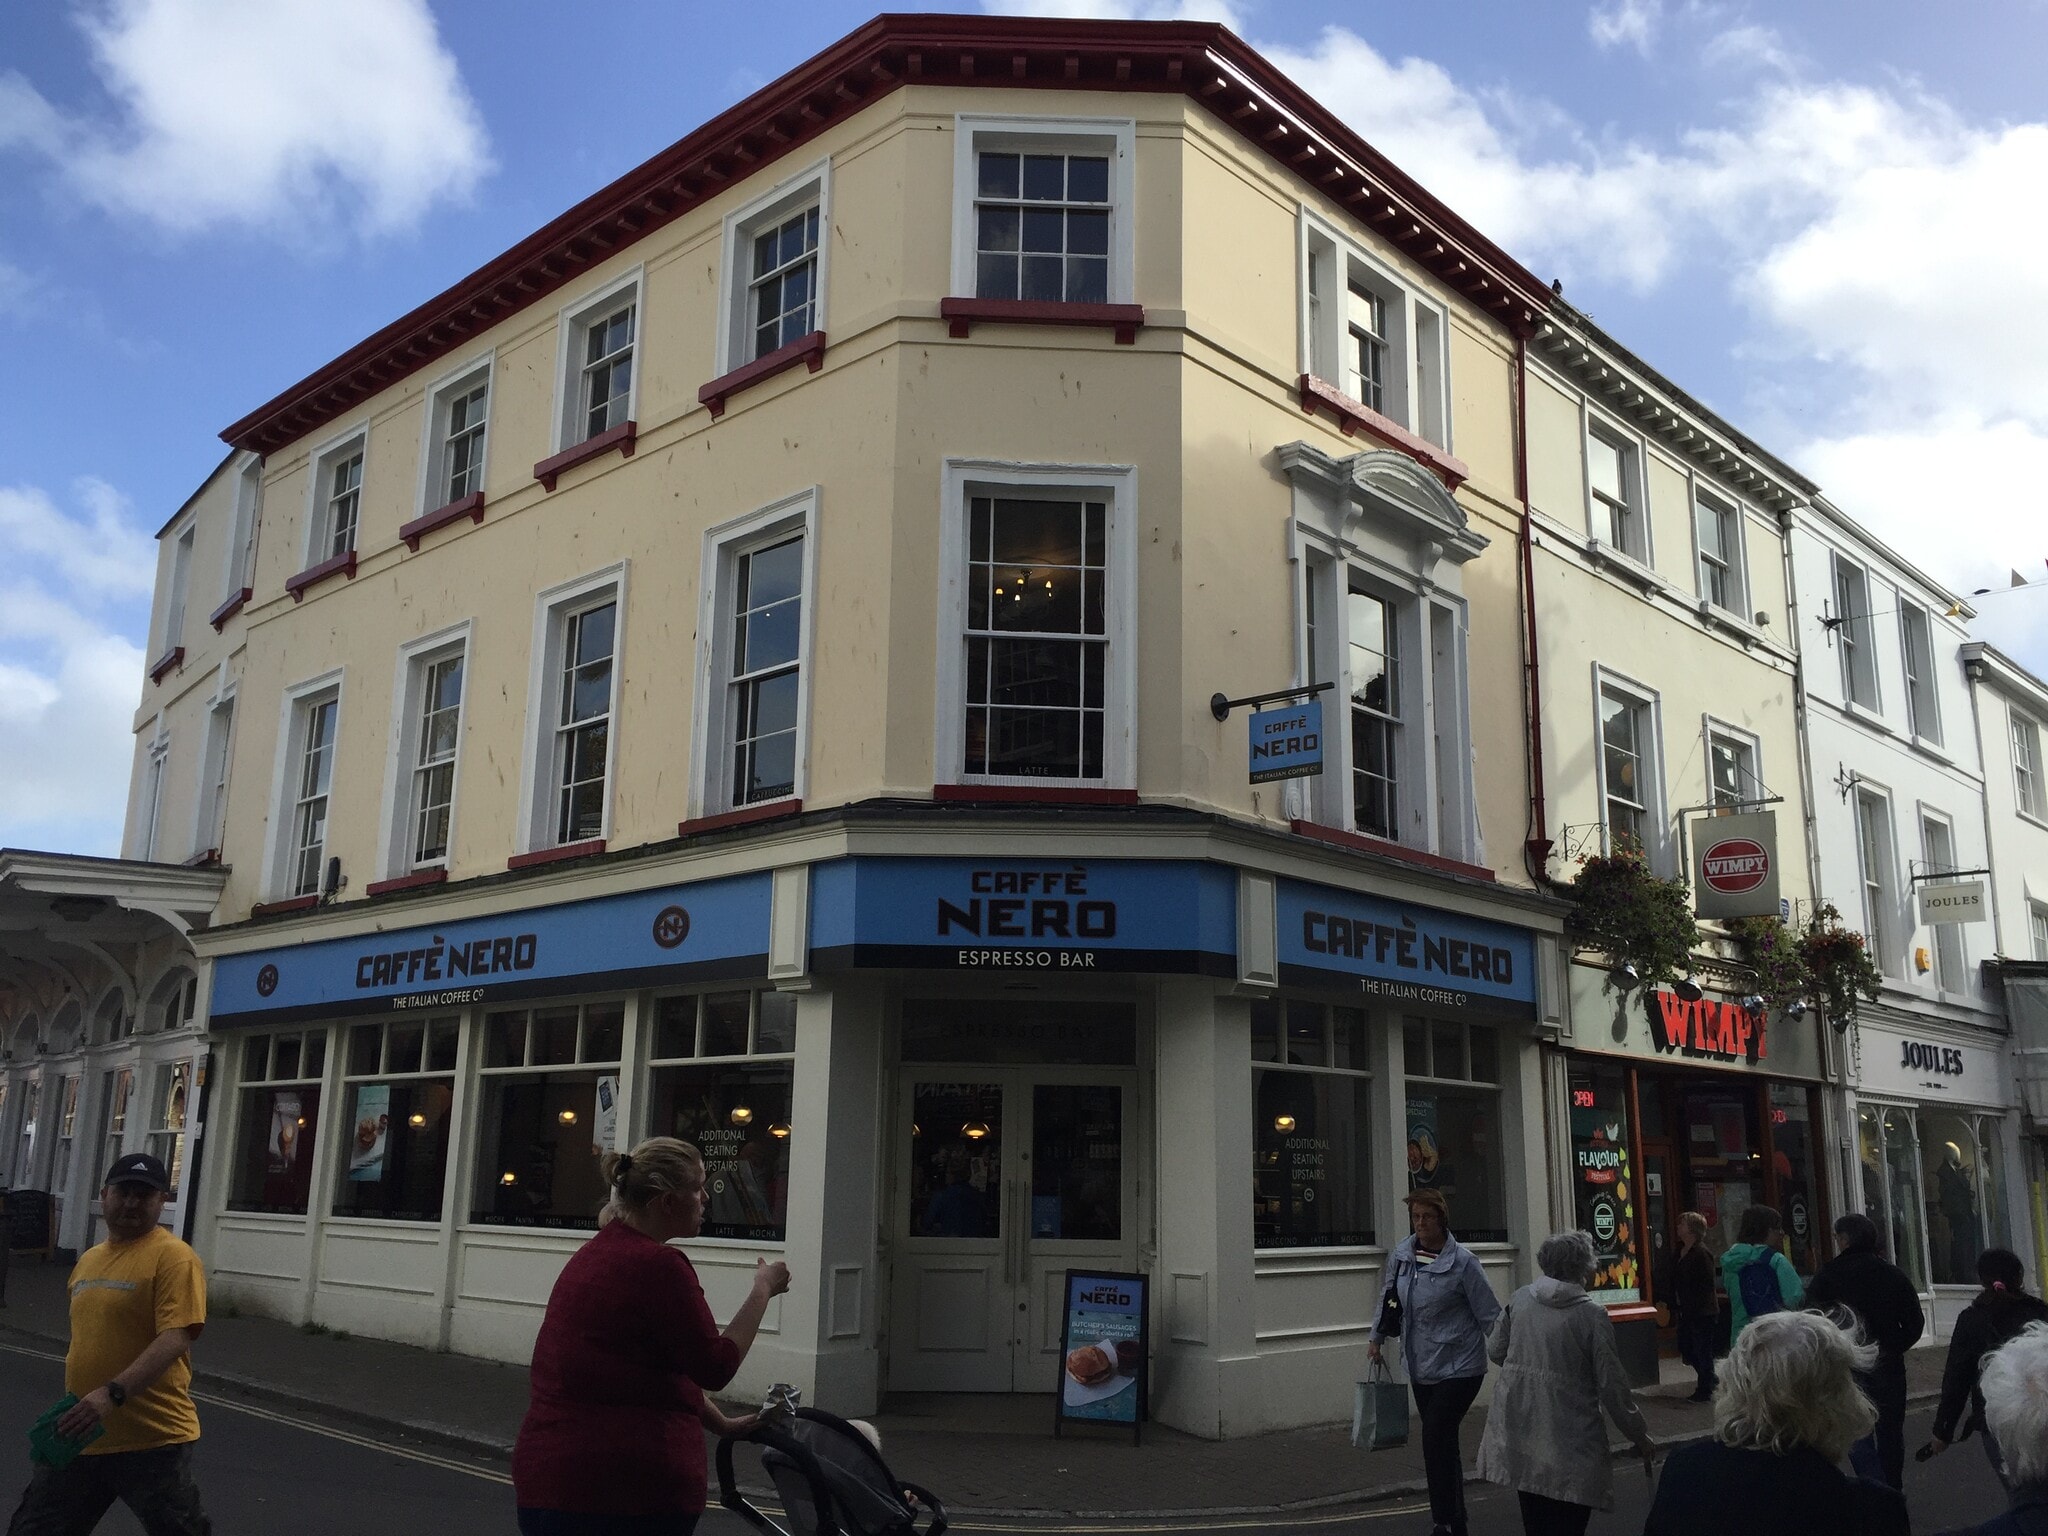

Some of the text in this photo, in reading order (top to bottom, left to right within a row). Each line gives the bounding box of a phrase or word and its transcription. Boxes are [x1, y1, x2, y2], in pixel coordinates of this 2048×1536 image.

[1265, 714, 1307, 734] CAFFÈ
[1253, 733, 1318, 760] NERO
[1019, 766, 1049, 775] LATTE
[1704, 856, 1767, 875] WIMPY
[971, 865, 1088, 895] CAFFÈ
[1925, 895, 1979, 909] JOULES
[937, 897, 1117, 940] NERO
[1303, 910, 1514, 985] CAFFÈ NERO
[355, 933, 538, 989] CAFFÈ NERO
[958, 950, 1096, 967] ESPRESSO BAR
[393, 997, 408, 1009] THE
[408, 993, 439, 1009] ITALIAN
[440, 990, 471, 1005] COFFEE
[1360, 978, 1379, 994] THE
[1381, 982, 1418, 999] ITALIAN
[1420, 988, 1453, 1005] COFFEE
[1657, 990, 1768, 1059] WIMPY
[1901, 1040, 1964, 1075] JOULES
[1573, 1090, 1595, 1107] OPEN
[698, 1129, 747, 1142] ADDITIONAL
[1285, 1138, 1330, 1150] ADDITIONAL
[704, 1145, 739, 1156] SEATING
[1292, 1153, 1324, 1165] SEATING
[703, 1160, 739, 1172] UPSTAIRS
[1578, 1150, 1620, 1169] FLAVOUR
[1291, 1169, 1326, 1181] UPSTAIRS
[715, 1227, 777, 1239] LATTE MOCHA
[1079, 1291, 1132, 1306] NERO
[1105, 1323, 1137, 1332] SAUSAGES
